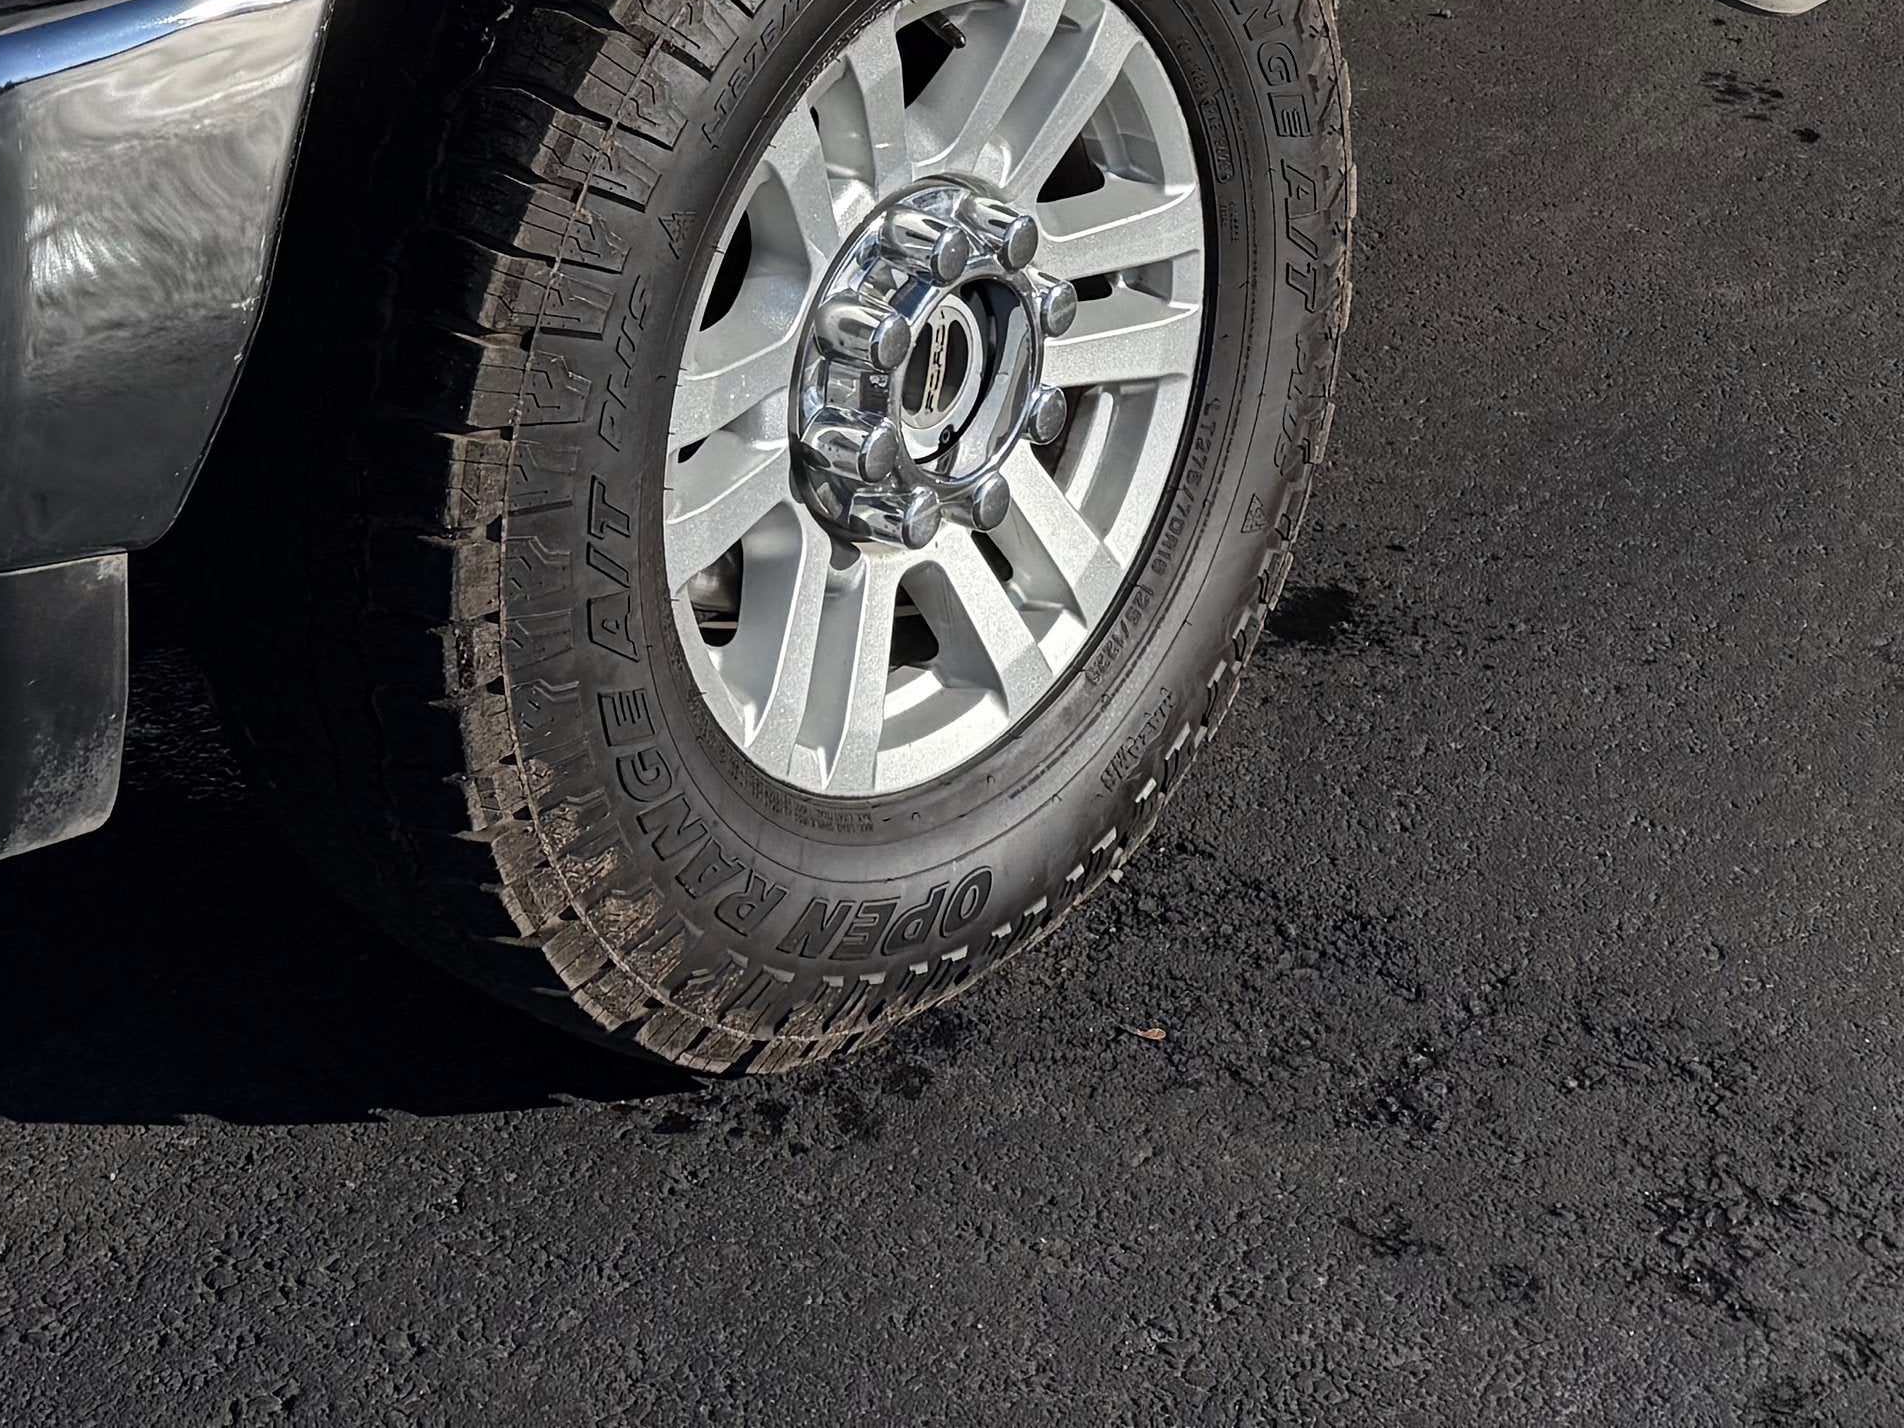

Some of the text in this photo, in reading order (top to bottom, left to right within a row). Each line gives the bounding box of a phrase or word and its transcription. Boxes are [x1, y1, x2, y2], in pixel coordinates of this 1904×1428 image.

[586, 474, 640, 663] A/T
[597, 686, 792, 938] RANGE
[776, 865, 993, 962] OPEN
